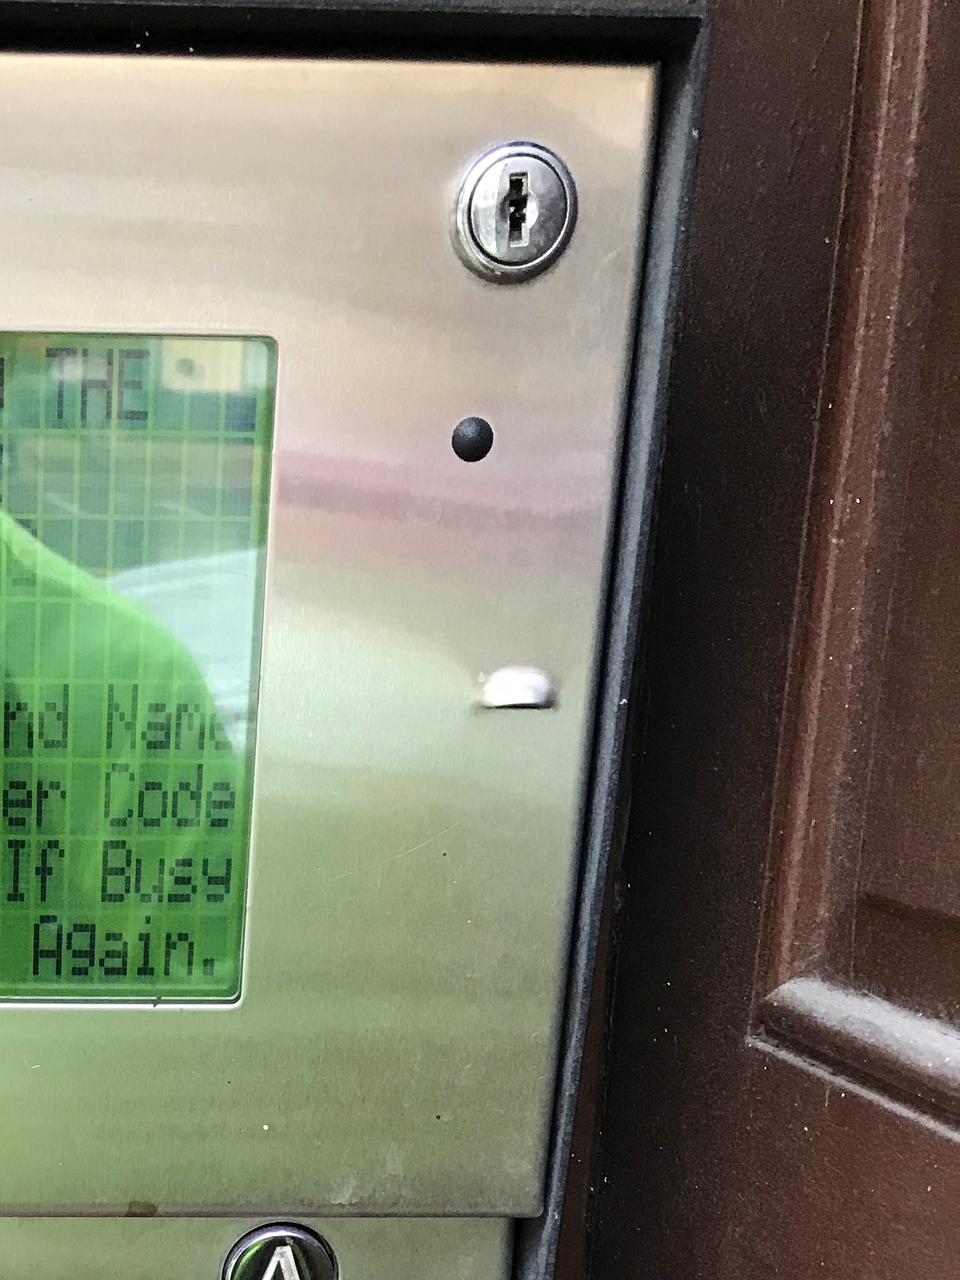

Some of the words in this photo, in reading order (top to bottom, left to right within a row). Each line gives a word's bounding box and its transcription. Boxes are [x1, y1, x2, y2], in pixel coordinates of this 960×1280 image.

[46, 347, 150, 421] THE
[104, 762, 236, 829] Code
[100, 839, 233, 904] Busy
[32, 914, 216, 977] Again.
